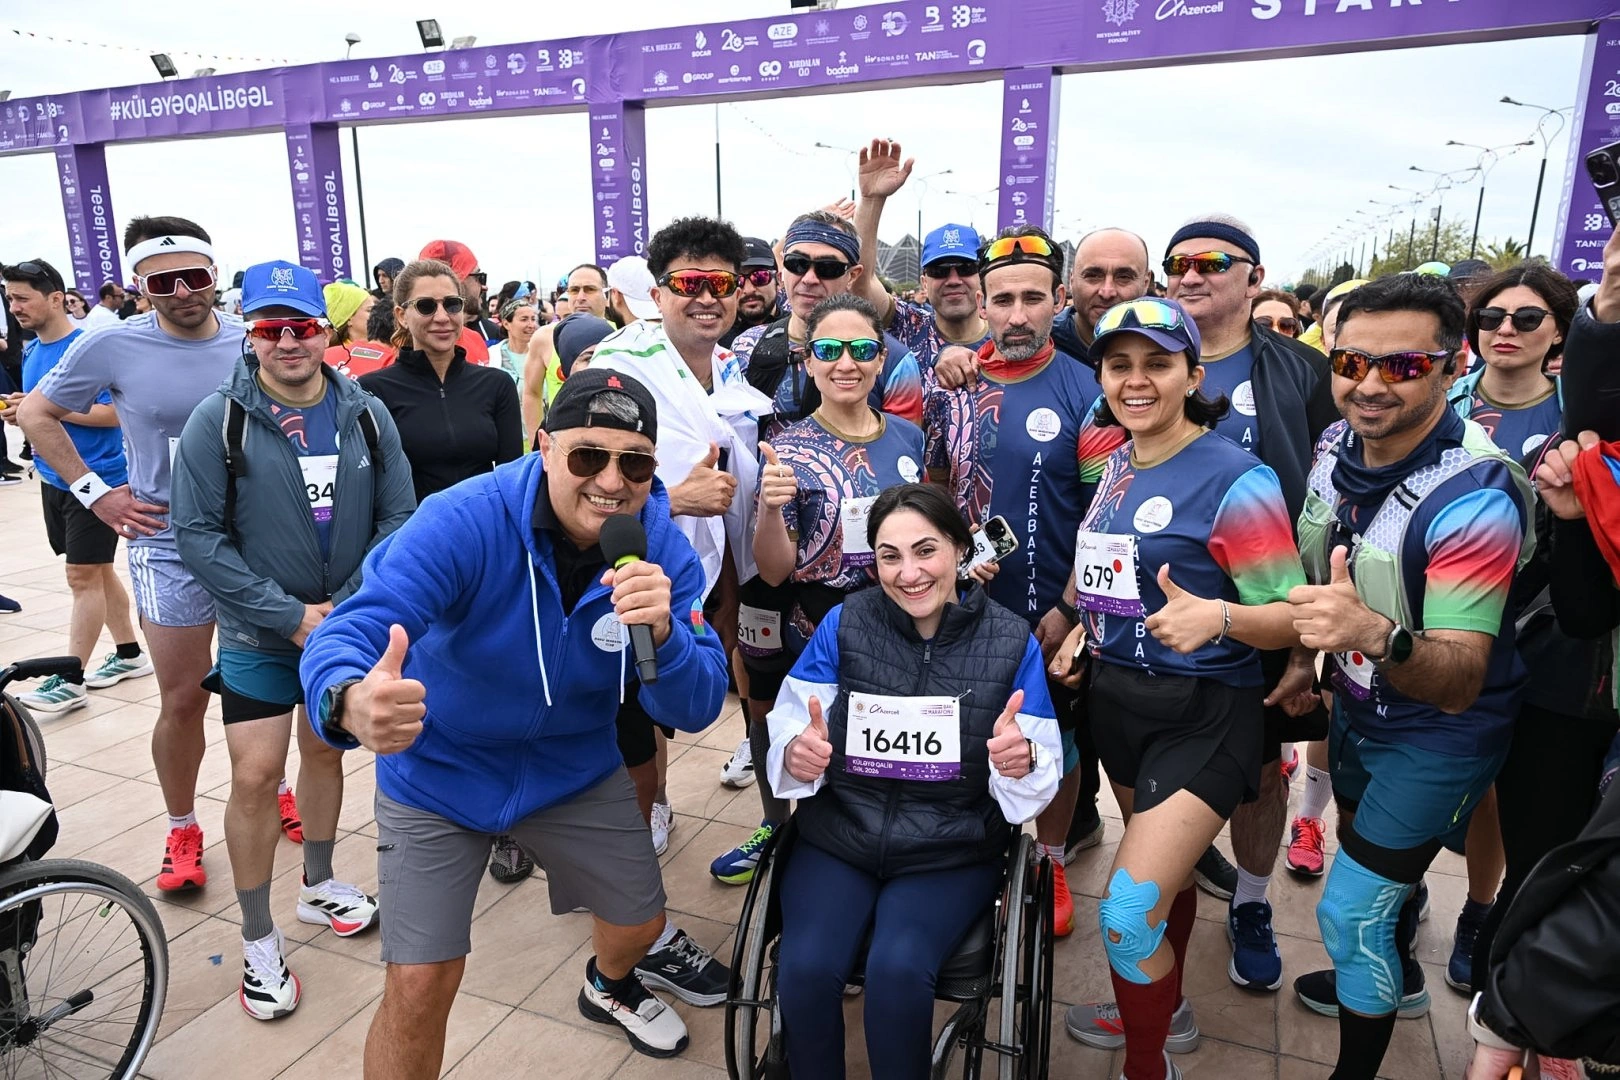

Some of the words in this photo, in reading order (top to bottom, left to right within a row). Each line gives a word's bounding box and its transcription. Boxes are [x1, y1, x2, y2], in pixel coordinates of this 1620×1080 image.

[1178, 1, 1224, 17] Azercell
[774, 26, 792, 36] AZE
[656, 42, 682, 52] BREEZE
[915, 52, 936, 61] TAN
[759, 60, 782, 76] GO
[110, 85, 273, 120] #KÜLƏYƏQALİBGƏL
[631, 157, 644, 257] QALİBGƏL
[324, 170, 344, 282] YƏQALİBGƏL
[1027, 452, 1042, 611] AZERBAIJAN
[1083, 565, 1113, 590] 679
[862, 728, 942, 755] 16416
